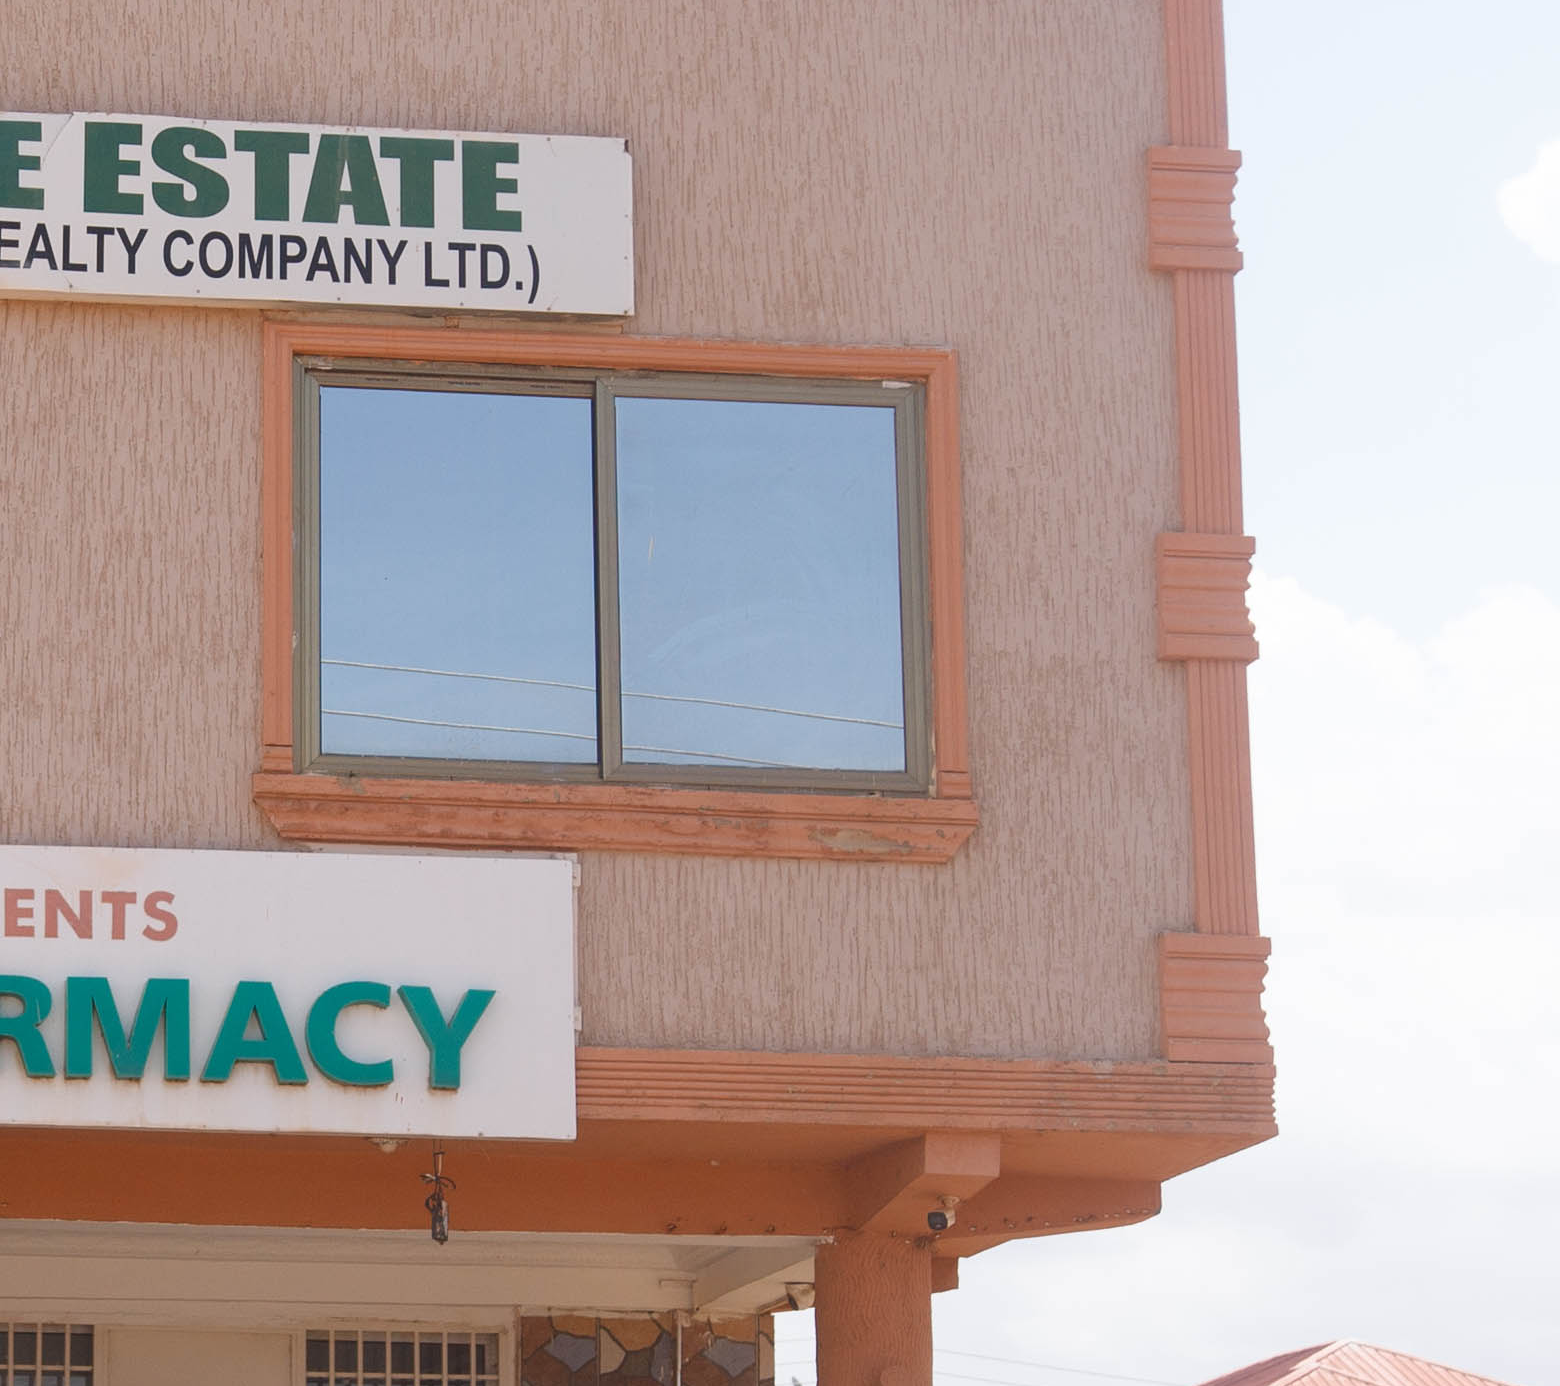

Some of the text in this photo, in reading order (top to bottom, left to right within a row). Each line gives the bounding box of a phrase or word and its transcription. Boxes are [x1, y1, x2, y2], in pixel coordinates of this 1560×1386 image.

[84, 122, 522, 232] ESTATE
[164, 230, 409, 286] COMPANY
[425, 242, 540, 305] LTD.)
